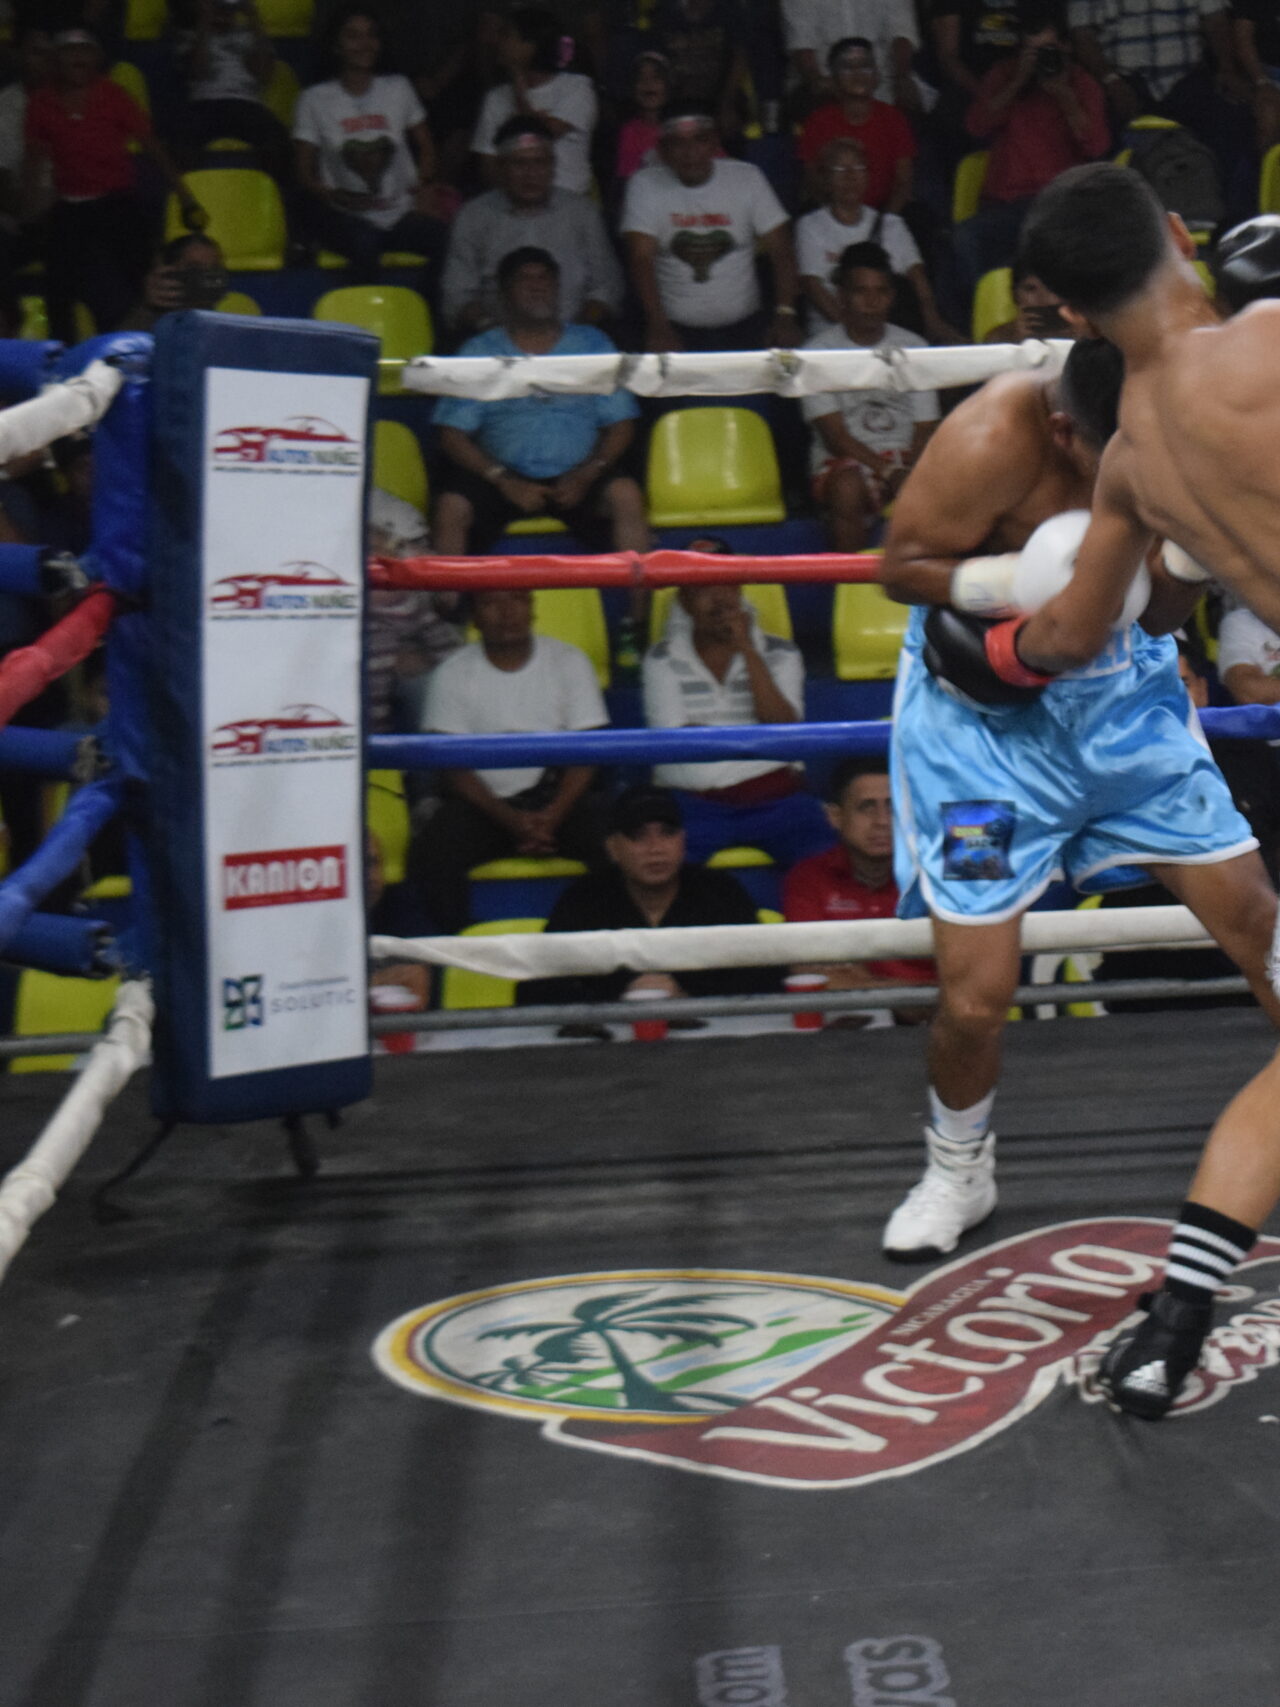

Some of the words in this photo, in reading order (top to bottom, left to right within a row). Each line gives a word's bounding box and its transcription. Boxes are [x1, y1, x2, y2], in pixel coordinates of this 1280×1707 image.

[225, 856, 340, 897] KANION
[890, 1277, 993, 1336] NICARAGUA
[700, 1244, 1167, 1453] Victoria
